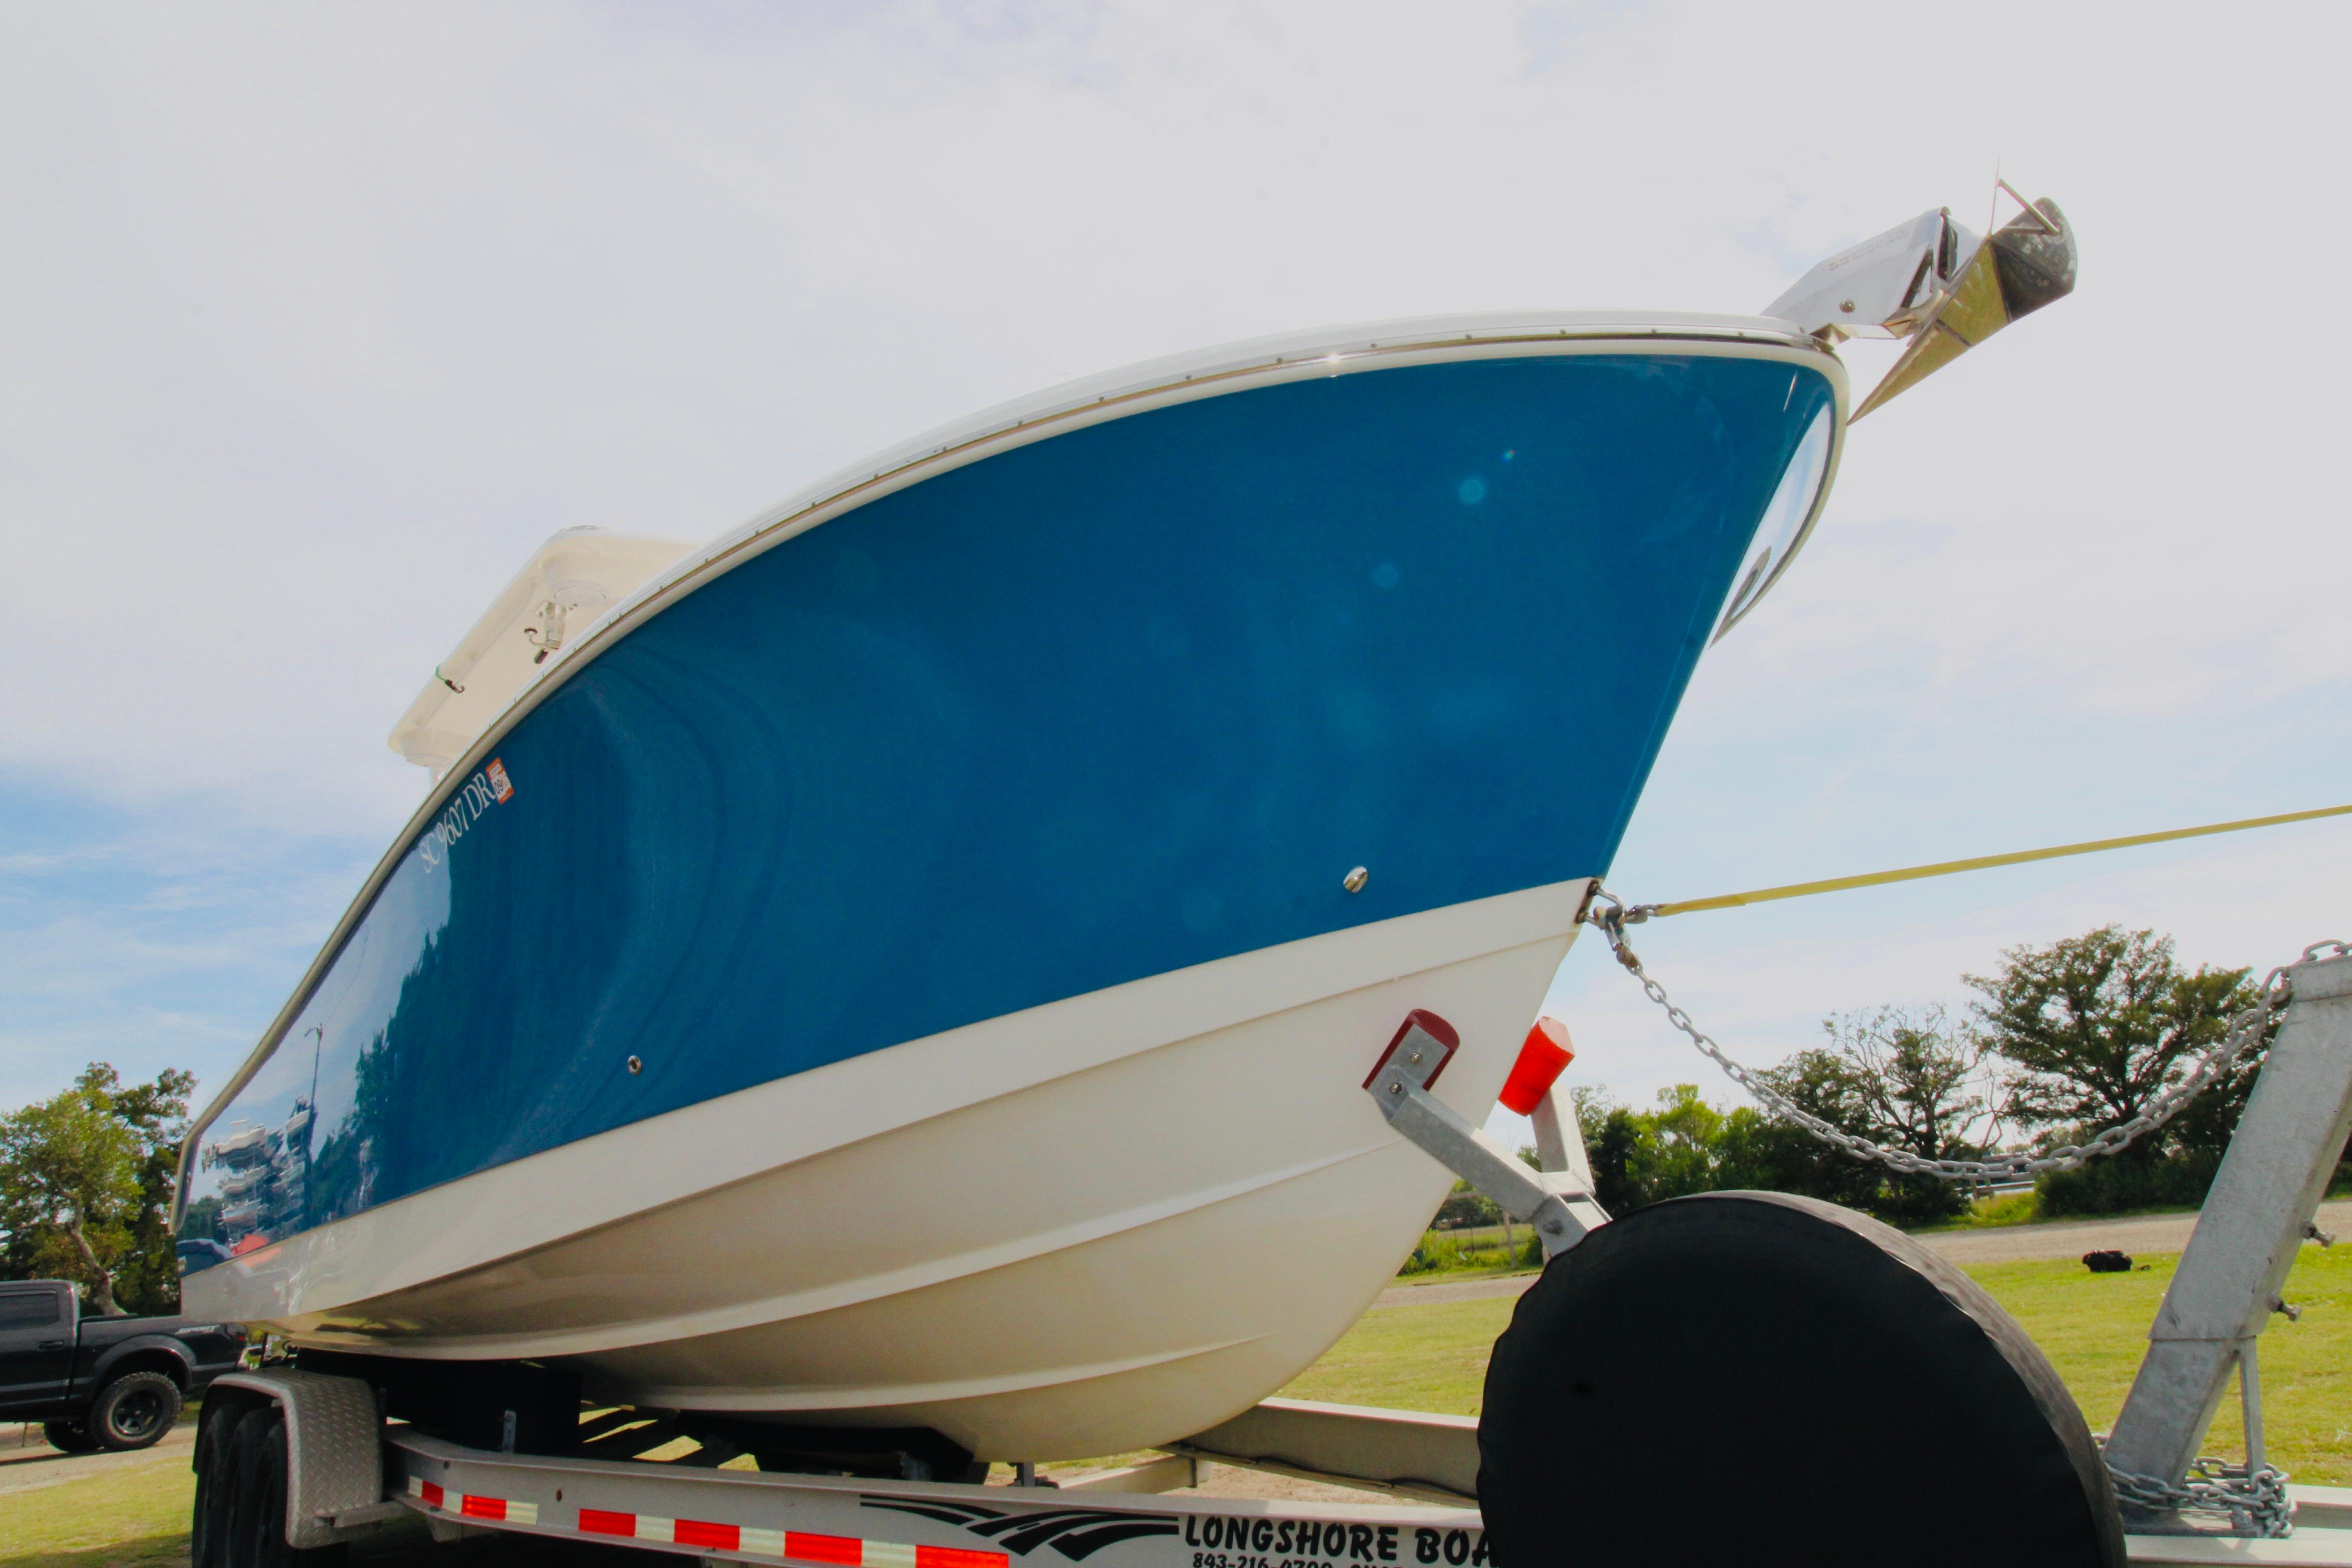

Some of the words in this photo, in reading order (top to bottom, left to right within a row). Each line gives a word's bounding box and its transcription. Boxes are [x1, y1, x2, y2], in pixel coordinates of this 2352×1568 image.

[436, 796, 469, 854] 9607
[463, 773, 496, 821] DR
[1185, 1514, 1399, 1562] LONGSHORE
